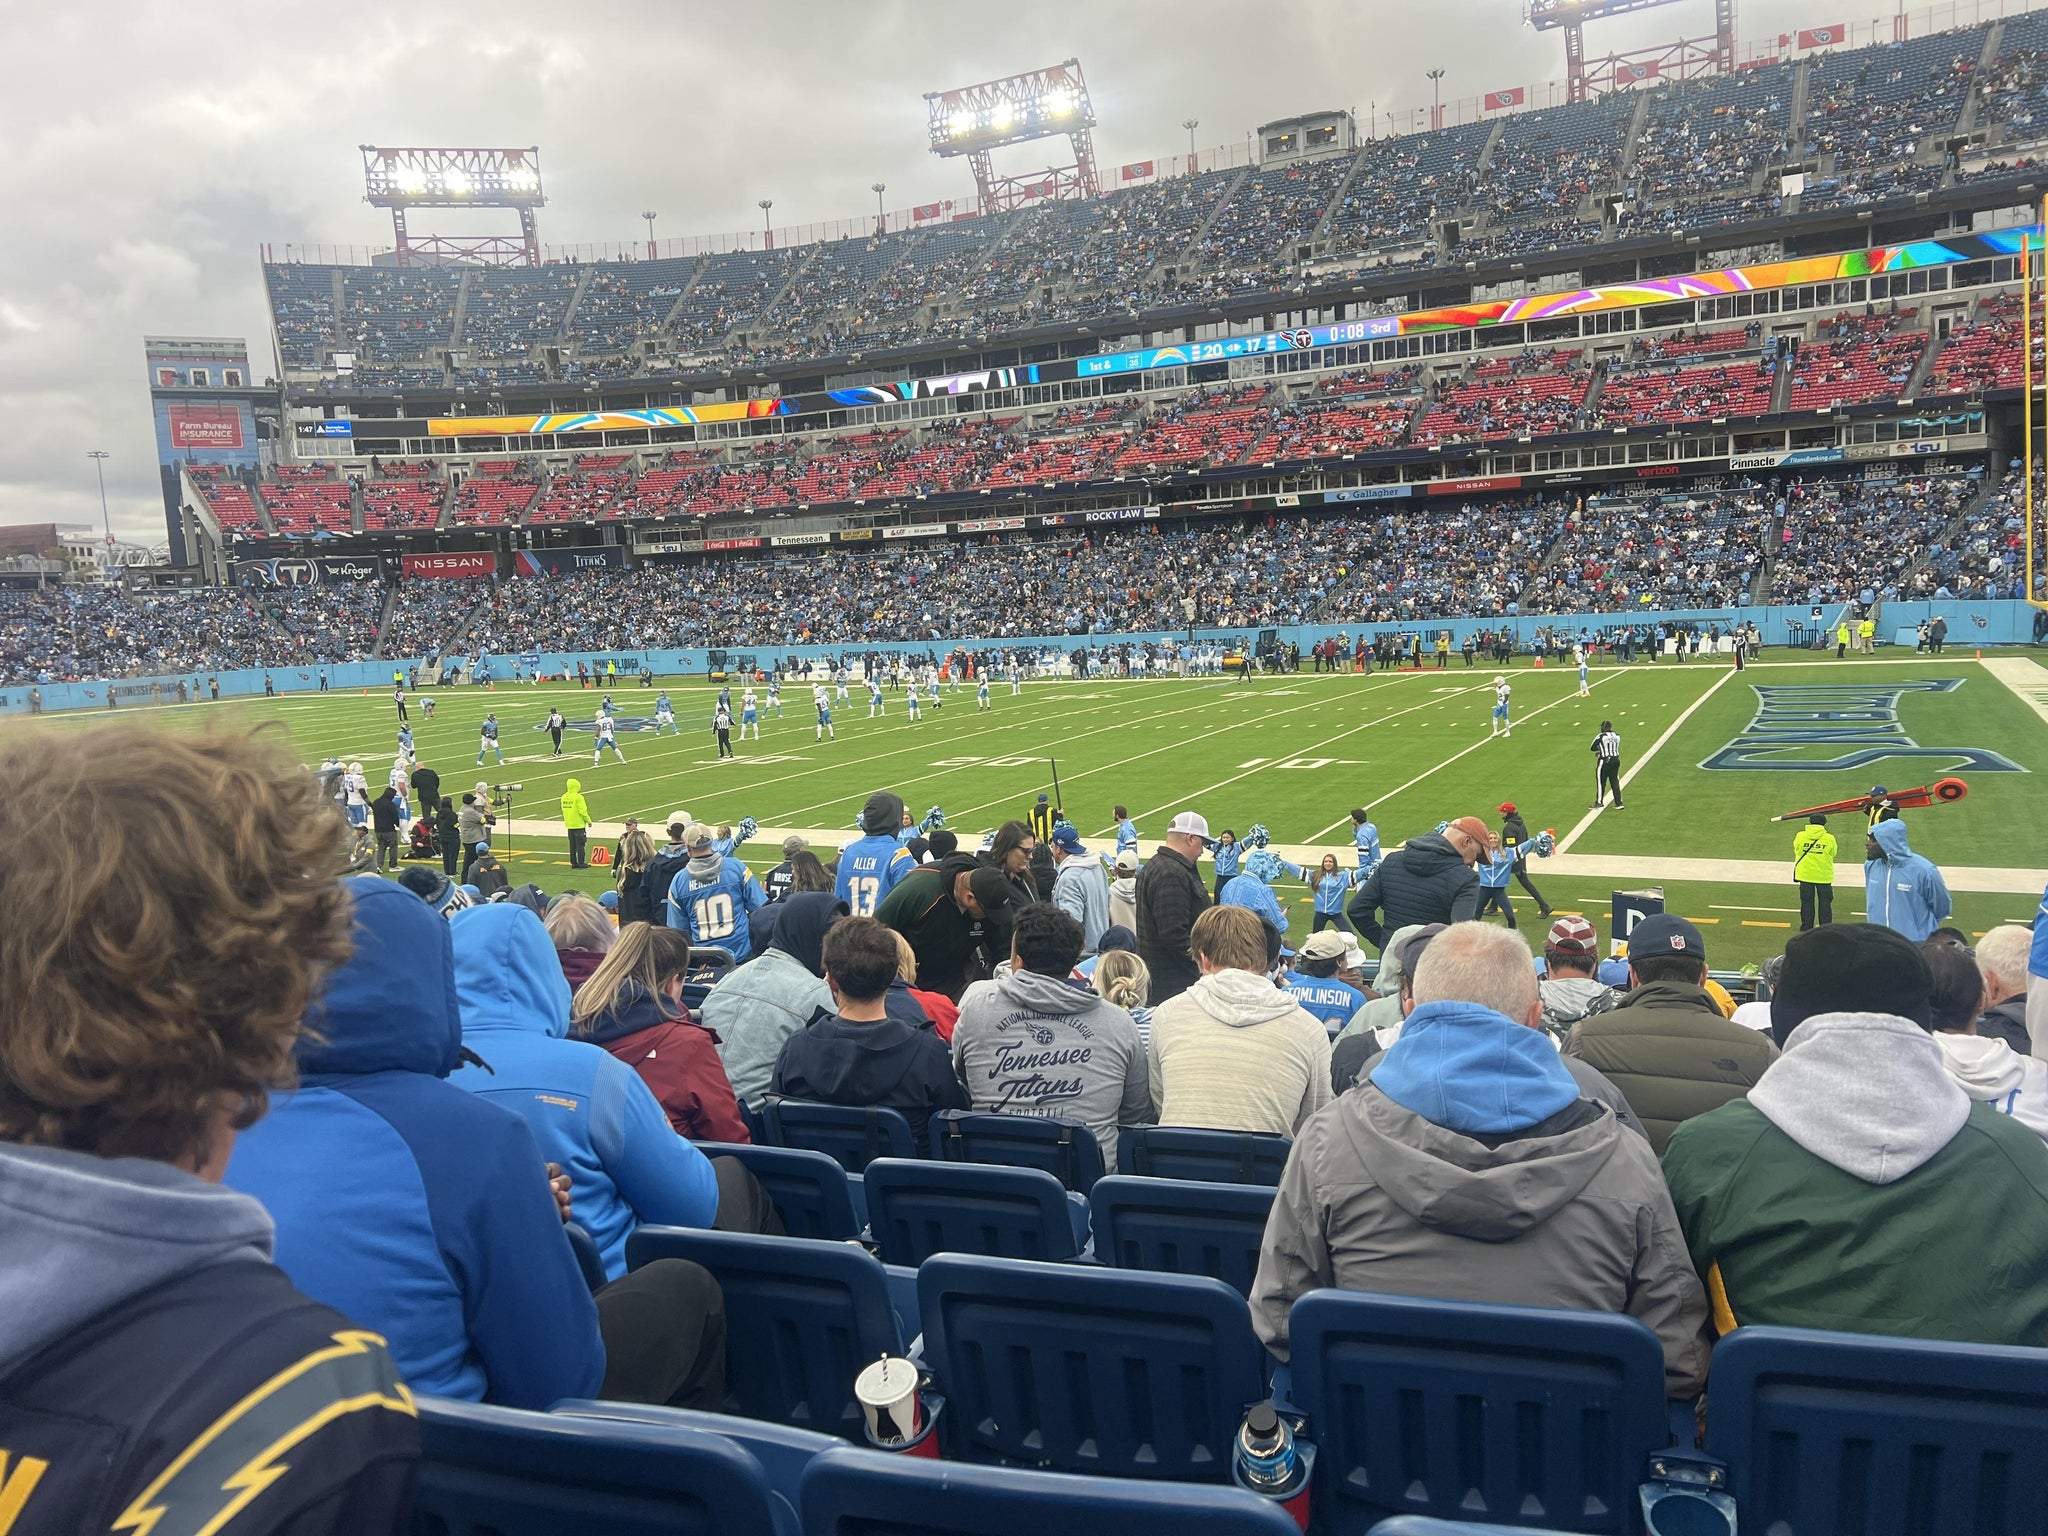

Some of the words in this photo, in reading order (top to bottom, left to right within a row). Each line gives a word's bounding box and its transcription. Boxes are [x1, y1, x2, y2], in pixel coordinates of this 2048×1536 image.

[1330, 323, 1364, 342] 0:08
[1370, 322, 1391, 335] 3rd
[1204, 343, 1223, 357] 20
[1247, 338, 1260, 352] 17
[1089, 362, 1102, 371] 1st
[1104, 362, 1111, 370] &
[179, 422, 202, 430] Farm
[203, 422, 232, 430] Bureau
[298, 425, 314, 434] 1:47
[179, 429, 233, 438] INSURANCE
[1731, 456, 1775, 469] Pinnacle
[1789, 452, 1842, 464] TitansBanking.com
[1636, 465, 1679, 476] verizon
[1864, 461, 1899, 472] FLOYD
[1456, 481, 1491, 490] NISSAN
[1352, 487, 1399, 501] Gallagher
[1279, 497, 1297, 505] WM
[1086, 511, 1118, 522] ROCKY
[1119, 509, 1141, 520] LAW
[414, 557, 484, 569] NISSAN
[573, 553, 607, 568] TITANS
[340, 562, 373, 579] Kroger
[1696, 678, 2032, 773] TITANS
[928, 756, 1040, 768] 20
[1236, 757, 1336, 770] 10
[592, 847, 604, 864] 20
[853, 857, 878, 870] ALLEN
[848, 876, 880, 917] 13
[693, 893, 735, 942] 10
[1287, 986, 1351, 1008] TOMLINSON
[995, 1011, 1031, 1033] NATIONAL
[1032, 1010, 1068, 1023] FOOTBALL
[1069, 1018, 1095, 1041] LEAGUE
[988, 1040, 1092, 1080] Tennessee
[989, 1073, 1084, 1114] Titans
